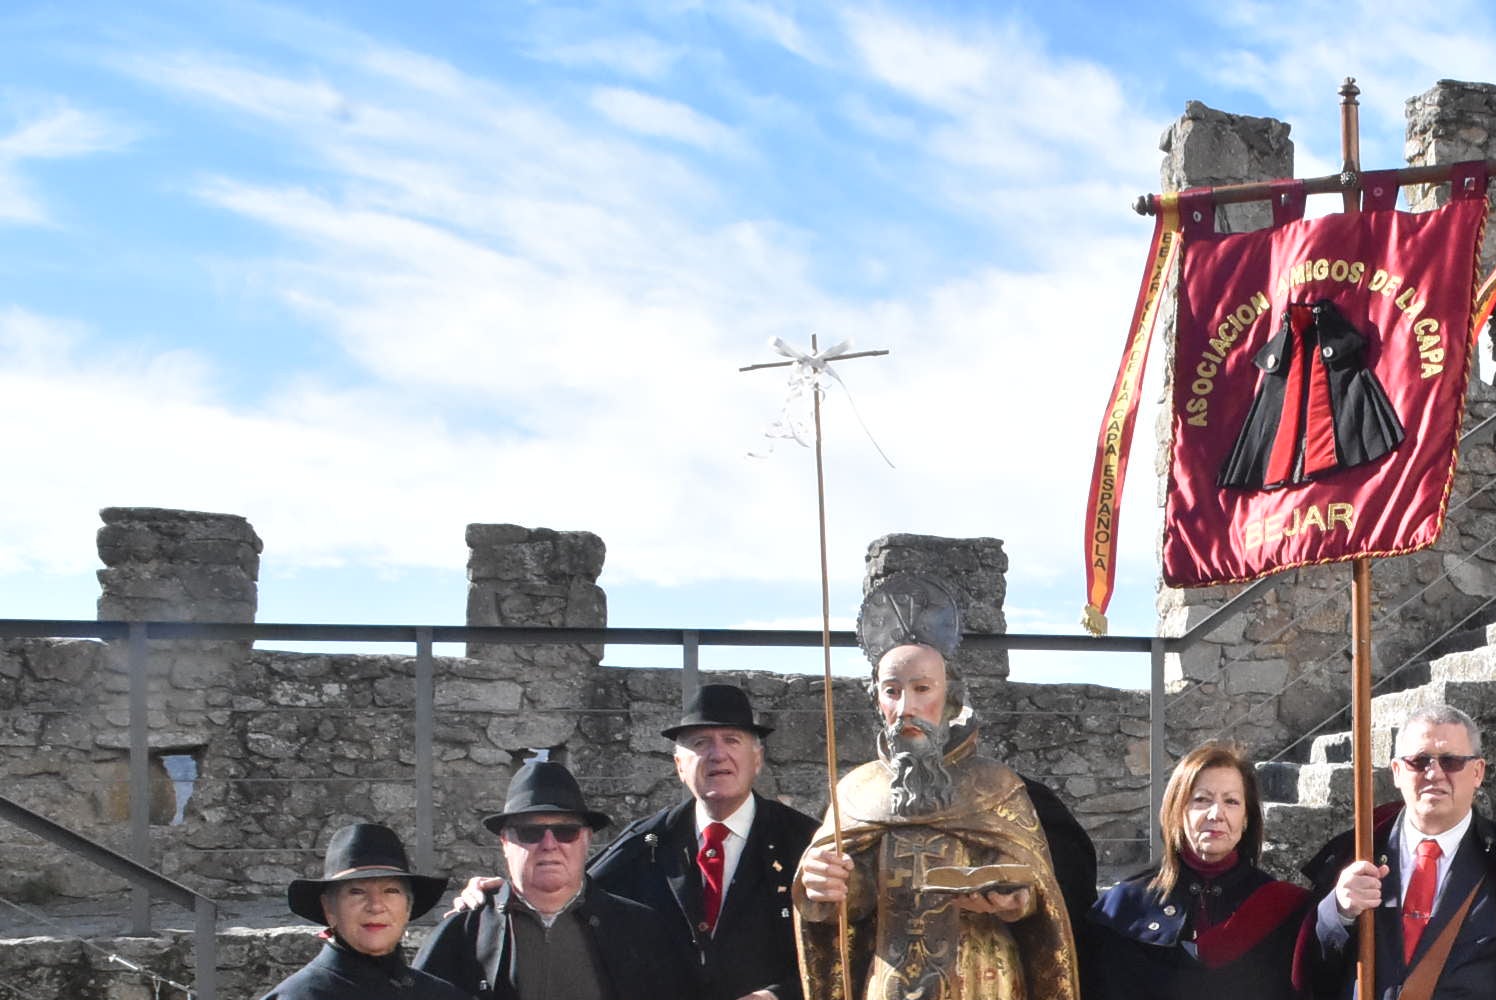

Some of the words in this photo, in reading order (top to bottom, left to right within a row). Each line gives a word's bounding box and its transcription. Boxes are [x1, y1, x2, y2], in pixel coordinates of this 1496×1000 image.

[1186, 291, 1271, 427] ASOCIACION
[1275, 258, 1365, 297] AMIGOS
[1368, 269, 1402, 298] DE
[1394, 287, 1426, 320] LA
[1413, 317, 1445, 380] CAPA
[1117, 380, 1130, 402] LA
[1104, 409, 1124, 457] CAPA
[1094, 464, 1115, 571] ESPAÑOLA
[1245, 502, 1354, 550] BEJAR
